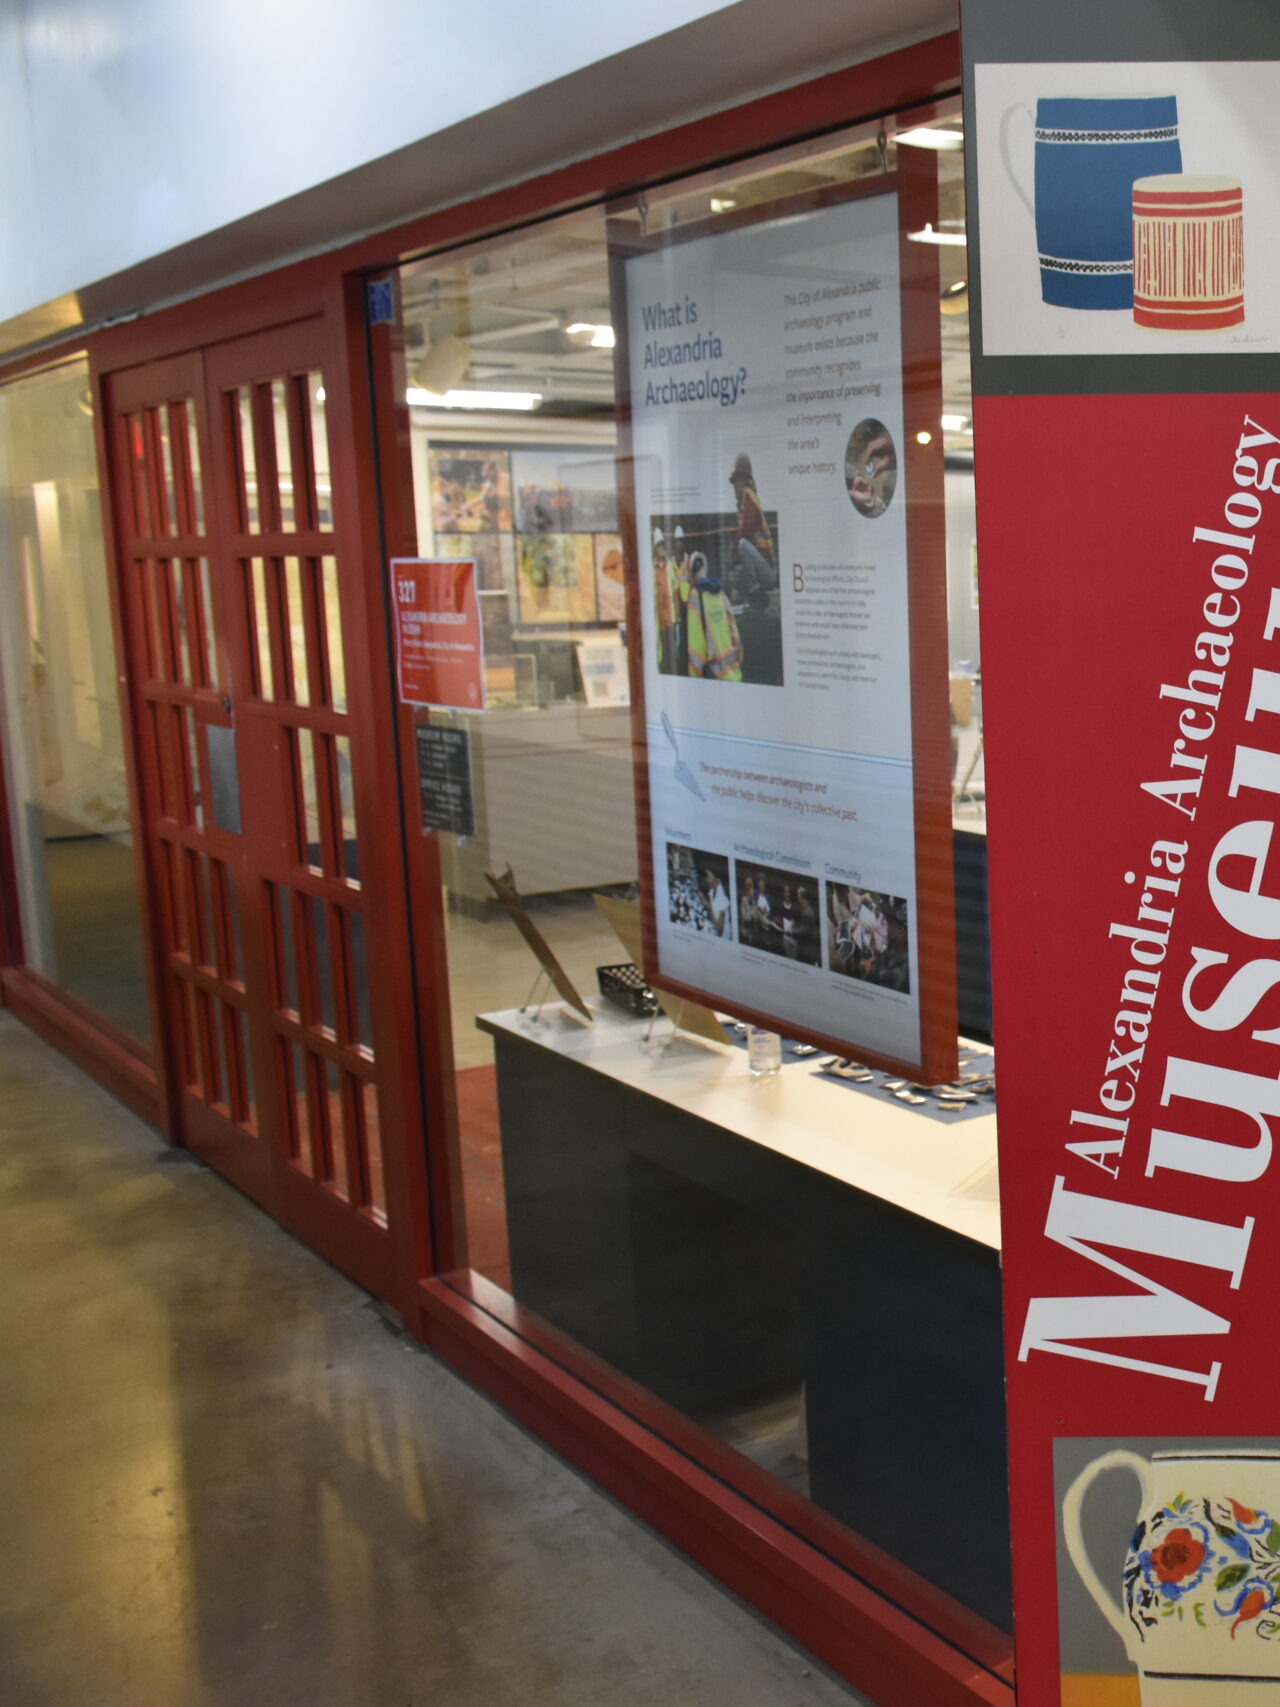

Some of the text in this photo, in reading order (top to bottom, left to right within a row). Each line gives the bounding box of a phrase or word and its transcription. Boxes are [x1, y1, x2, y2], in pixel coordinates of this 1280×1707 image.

[642, 295, 697, 331] What is
[644, 330, 723, 368] Alexandria
[645, 367, 747, 407] Archaeology?
[824, 862, 861, 884] Community
[1064, 839, 1192, 1179] Alexandria
